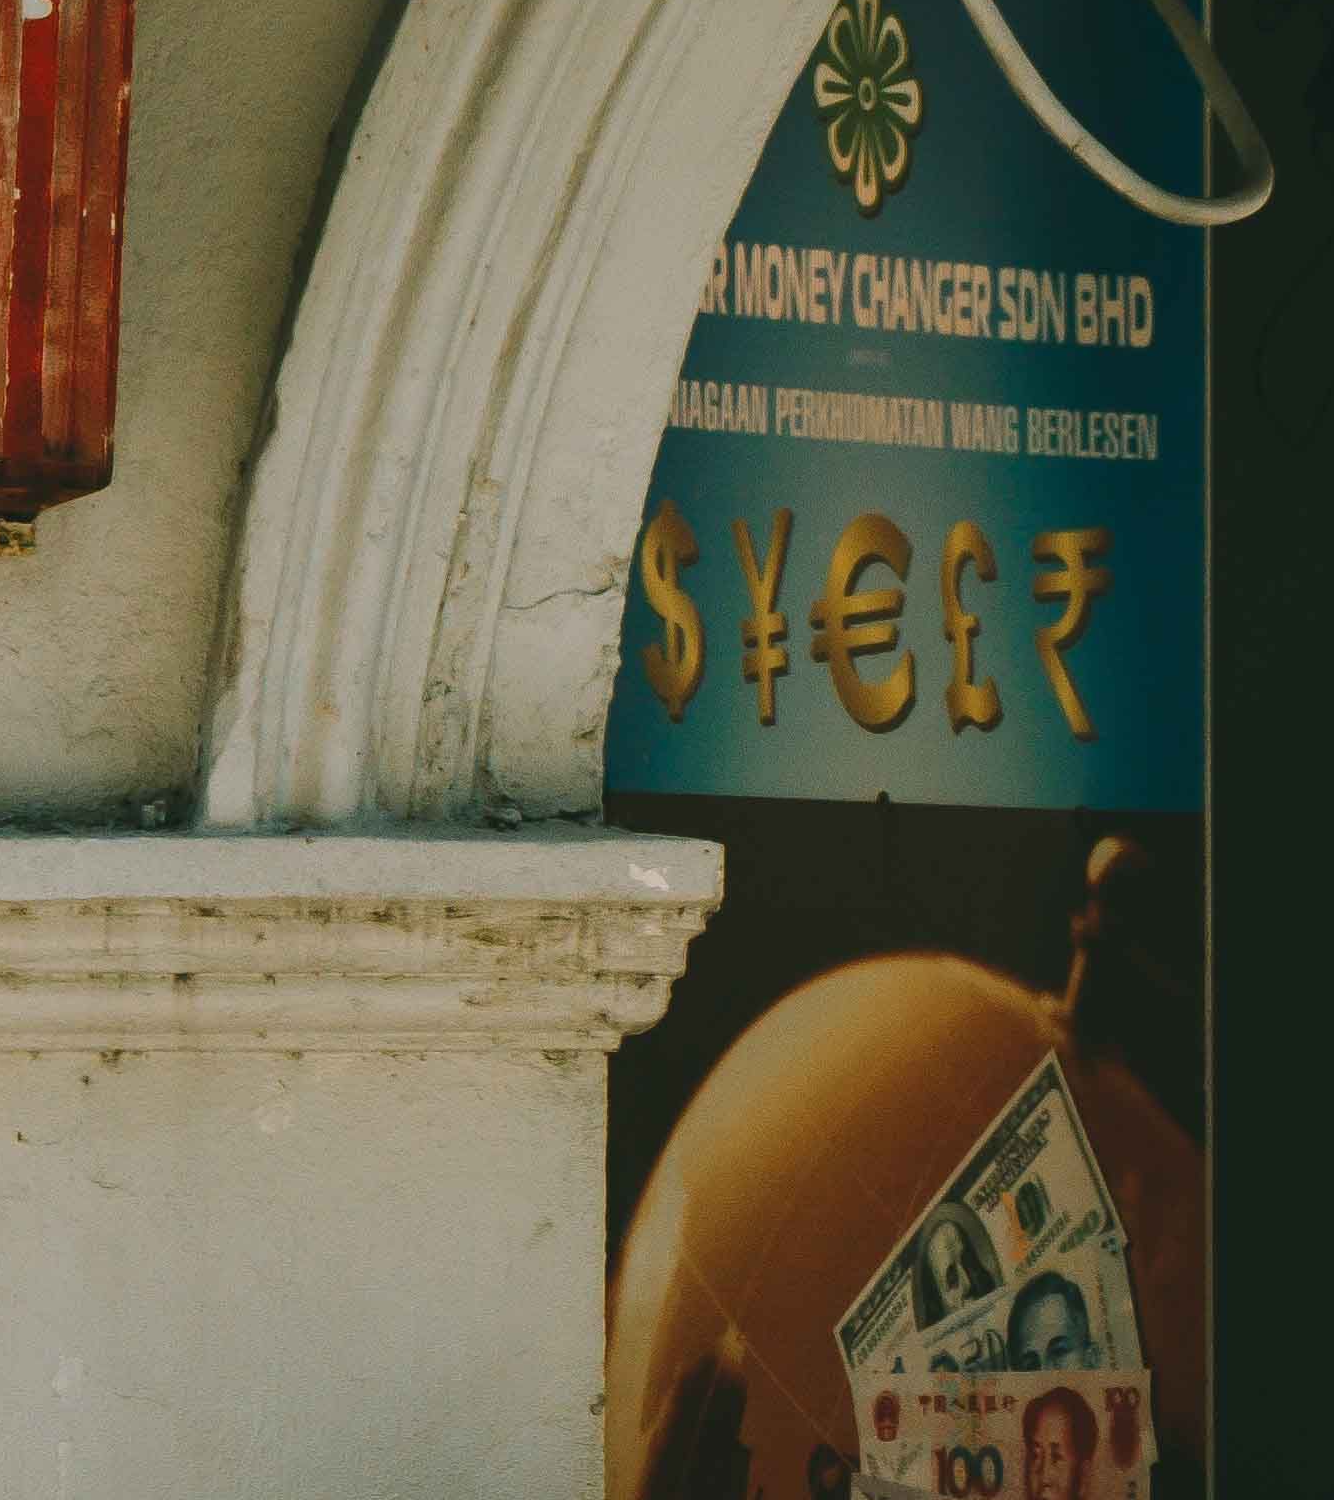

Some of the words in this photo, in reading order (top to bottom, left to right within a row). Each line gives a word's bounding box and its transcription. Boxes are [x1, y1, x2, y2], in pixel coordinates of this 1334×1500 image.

[734, 241, 849, 325] MONEY
[852, 253, 992, 339] CHANGER
[997, 267, 1066, 344] SDN
[1075, 272, 1154, 348] BHD
[950, 402, 1019, 453] WANG
[1026, 406, 1159, 460] BERLESEN
[934, 1443, 1004, 1500] 100
